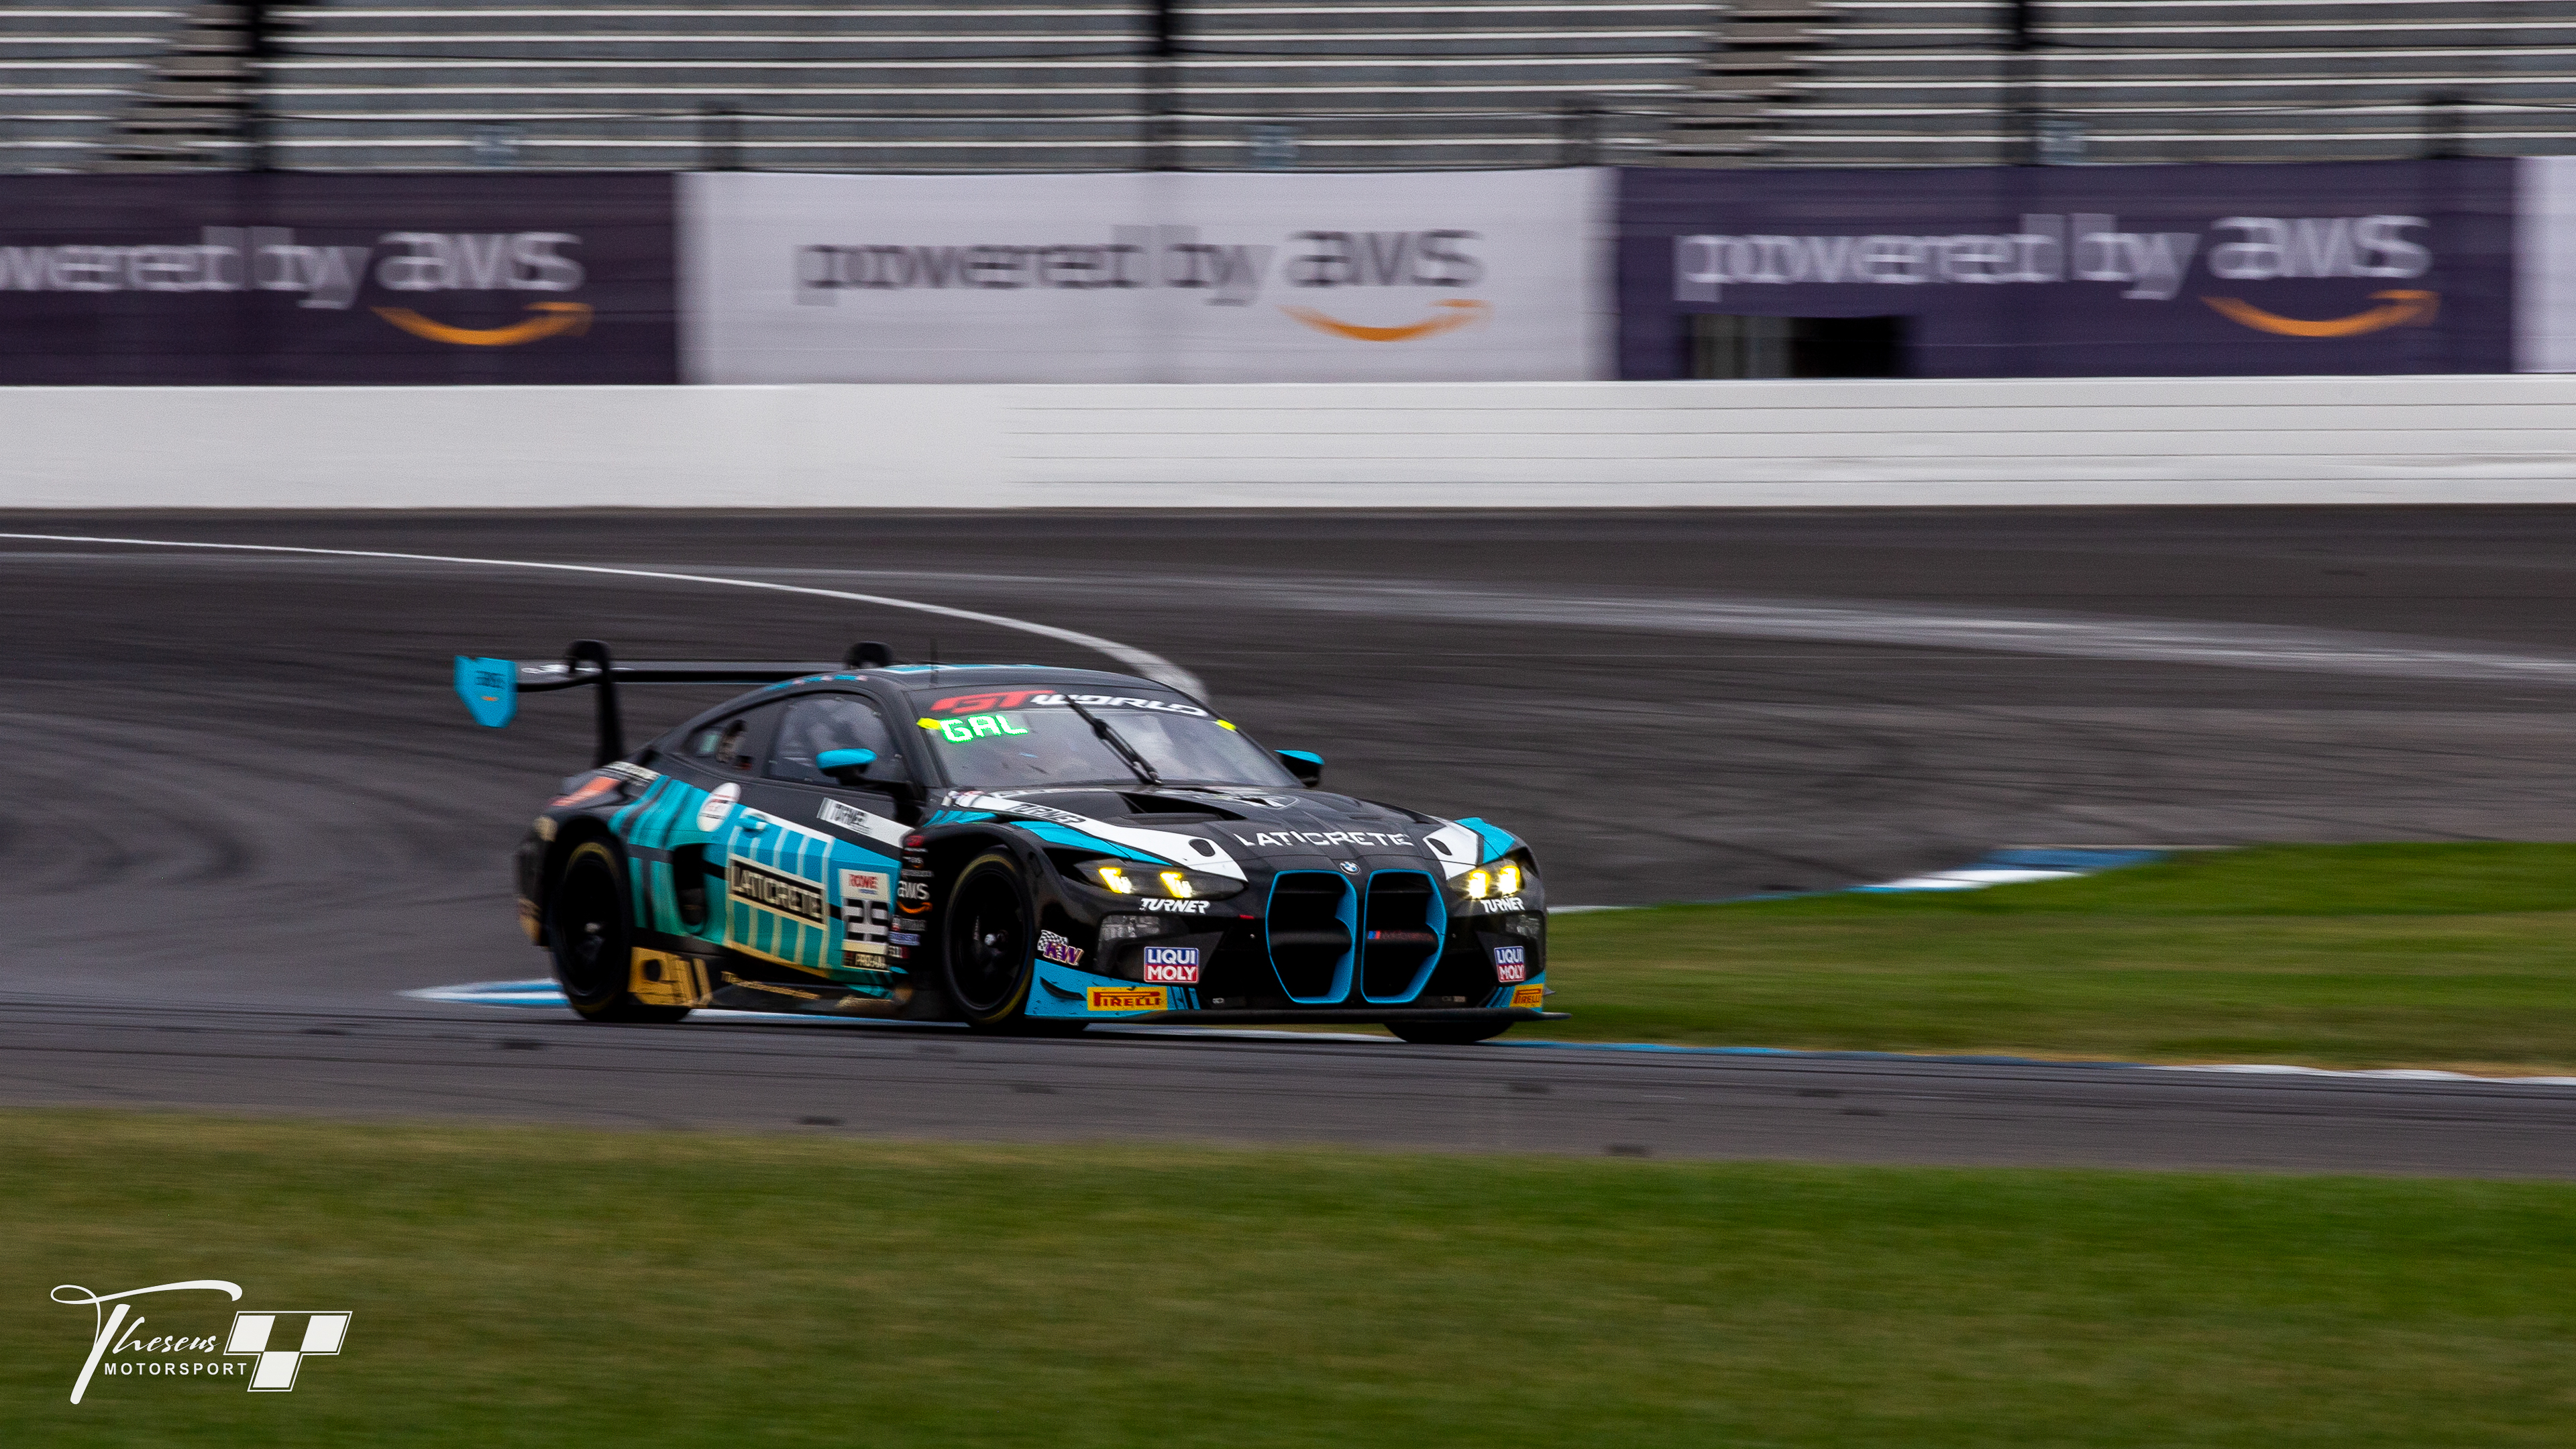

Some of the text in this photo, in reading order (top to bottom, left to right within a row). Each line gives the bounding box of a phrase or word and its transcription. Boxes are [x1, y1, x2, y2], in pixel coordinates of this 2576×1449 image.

[375, 231, 586, 292] aws
[793, 224, 1486, 307] powered by aws
[1673, 213, 2433, 302] powered by aws
[940, 714, 1028, 743] GAL
[1233, 830, 1415, 847] LATICRETE
[731, 865, 822, 920] LATICRETE
[898, 879, 930, 901] aws
[1139, 897, 1211, 914] TURNER
[1480, 896, 1525, 914] TURNER
[1042, 941, 1085, 967] KW
[1147, 949, 1195, 965] LIQUI
[1496, 949, 1523, 964] LIQUI
[1147, 965, 1197, 982] MOLY
[1498, 965, 1526, 981] MOLY
[1093, 991, 1161, 1008] PIRELLI
[1513, 987, 1542, 1005] PIRELLI
